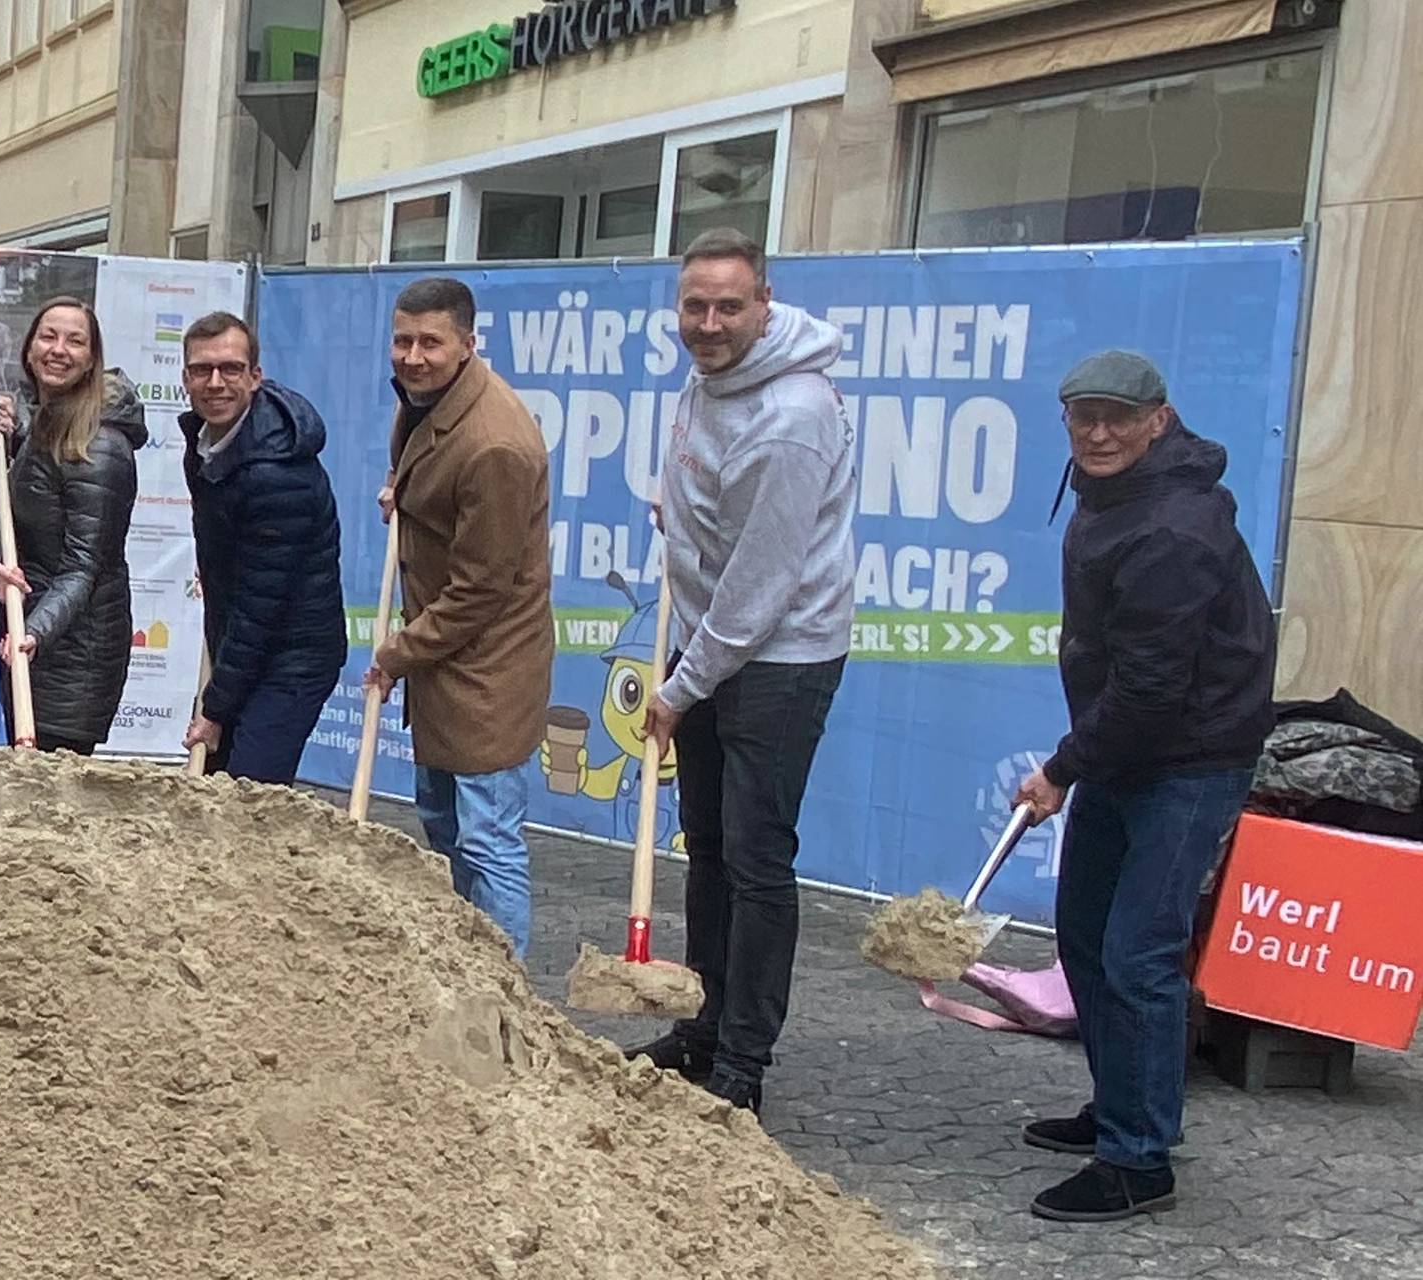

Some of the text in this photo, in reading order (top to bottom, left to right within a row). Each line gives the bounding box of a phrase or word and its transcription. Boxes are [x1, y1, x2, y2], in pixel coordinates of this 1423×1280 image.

[417, 24, 512, 98] GEERS
[153, 353, 181, 366] Werl
[508, 291, 678, 376] WÄR'S
[829, 304, 1030, 380] EINEM
[850, 623, 931, 652] ERL'S!
[377, 737, 415, 764] Plätz
[1241, 882, 1341, 933] Werl
[1229, 920, 1415, 993] baut um
